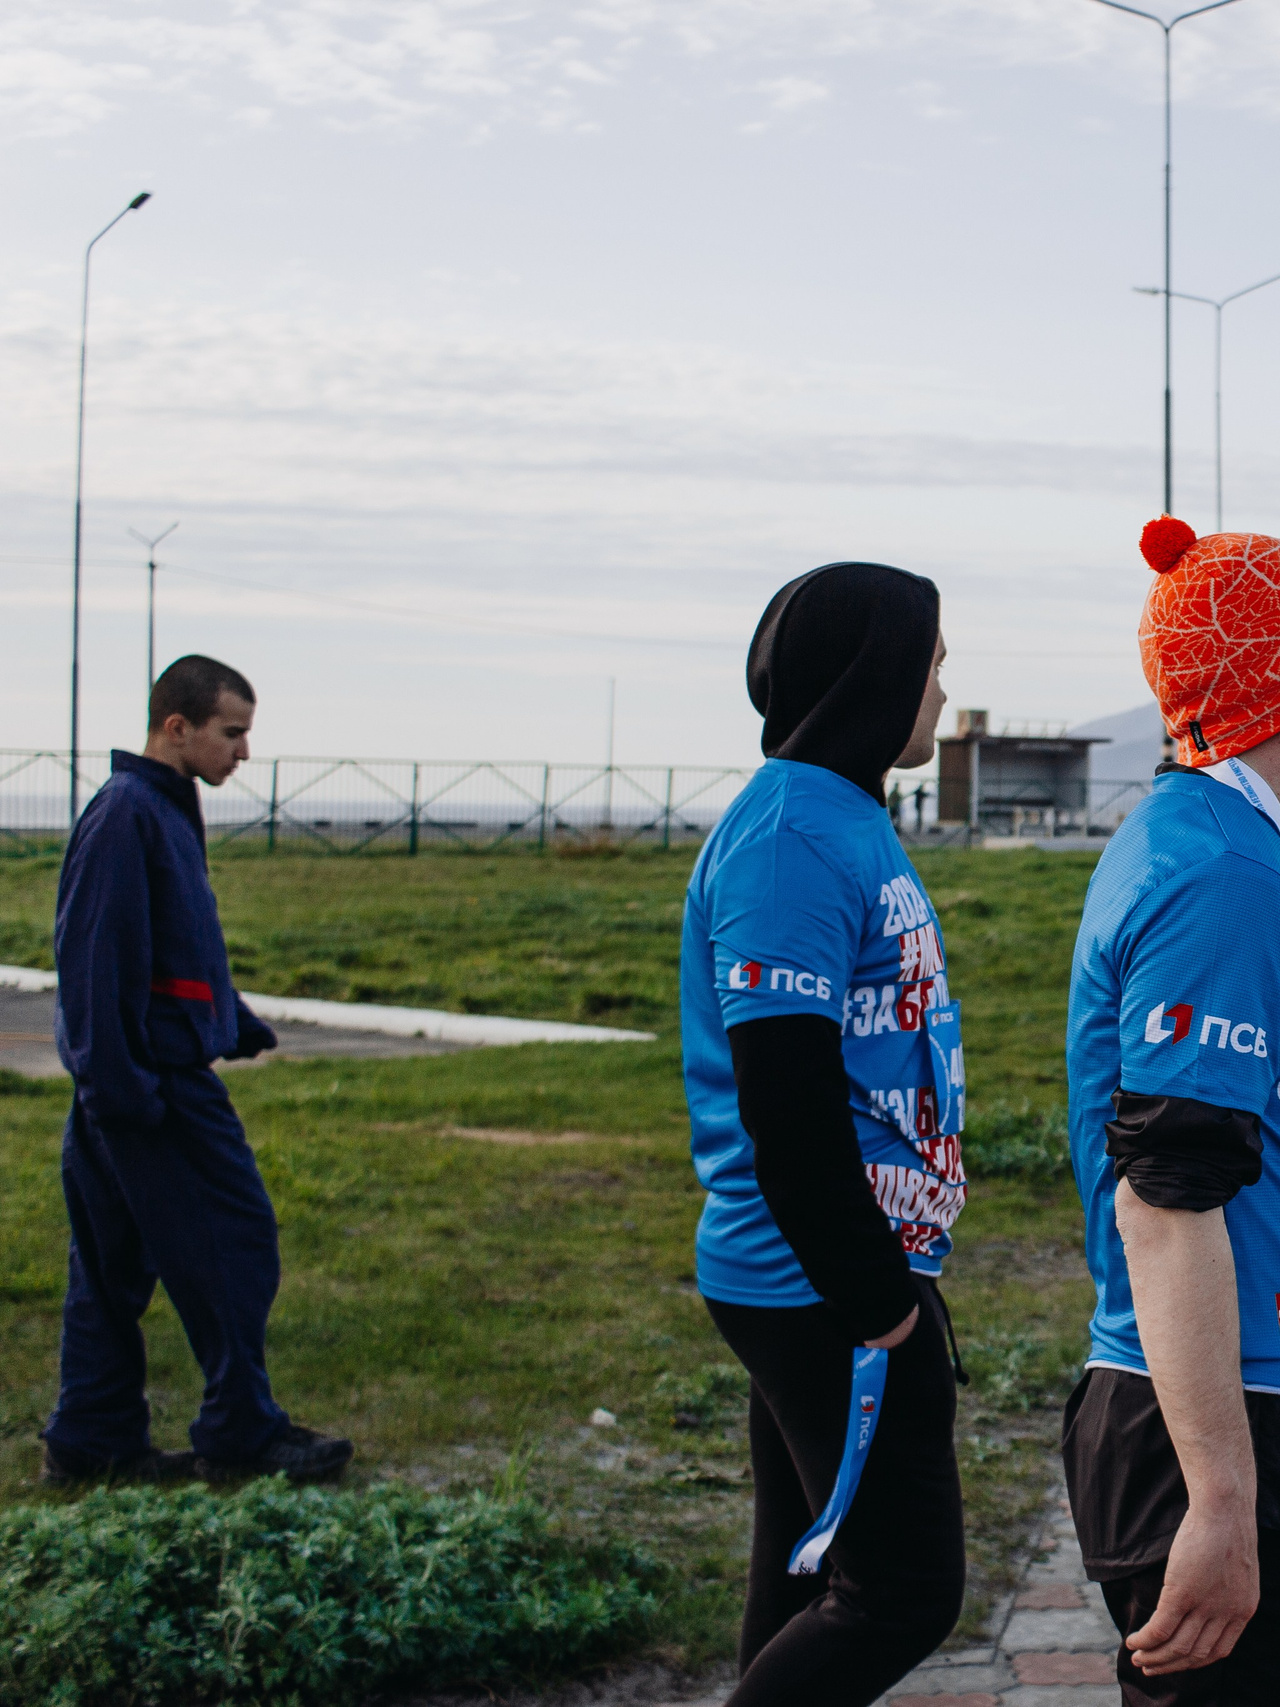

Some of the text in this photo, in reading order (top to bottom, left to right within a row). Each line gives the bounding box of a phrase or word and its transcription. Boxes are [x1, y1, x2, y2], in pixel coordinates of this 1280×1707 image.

[770, 967, 832, 1000] ПСБ
[1199, 1015, 1268, 1058] ПСБ
[858, 1416, 872, 1450] ПСБ
